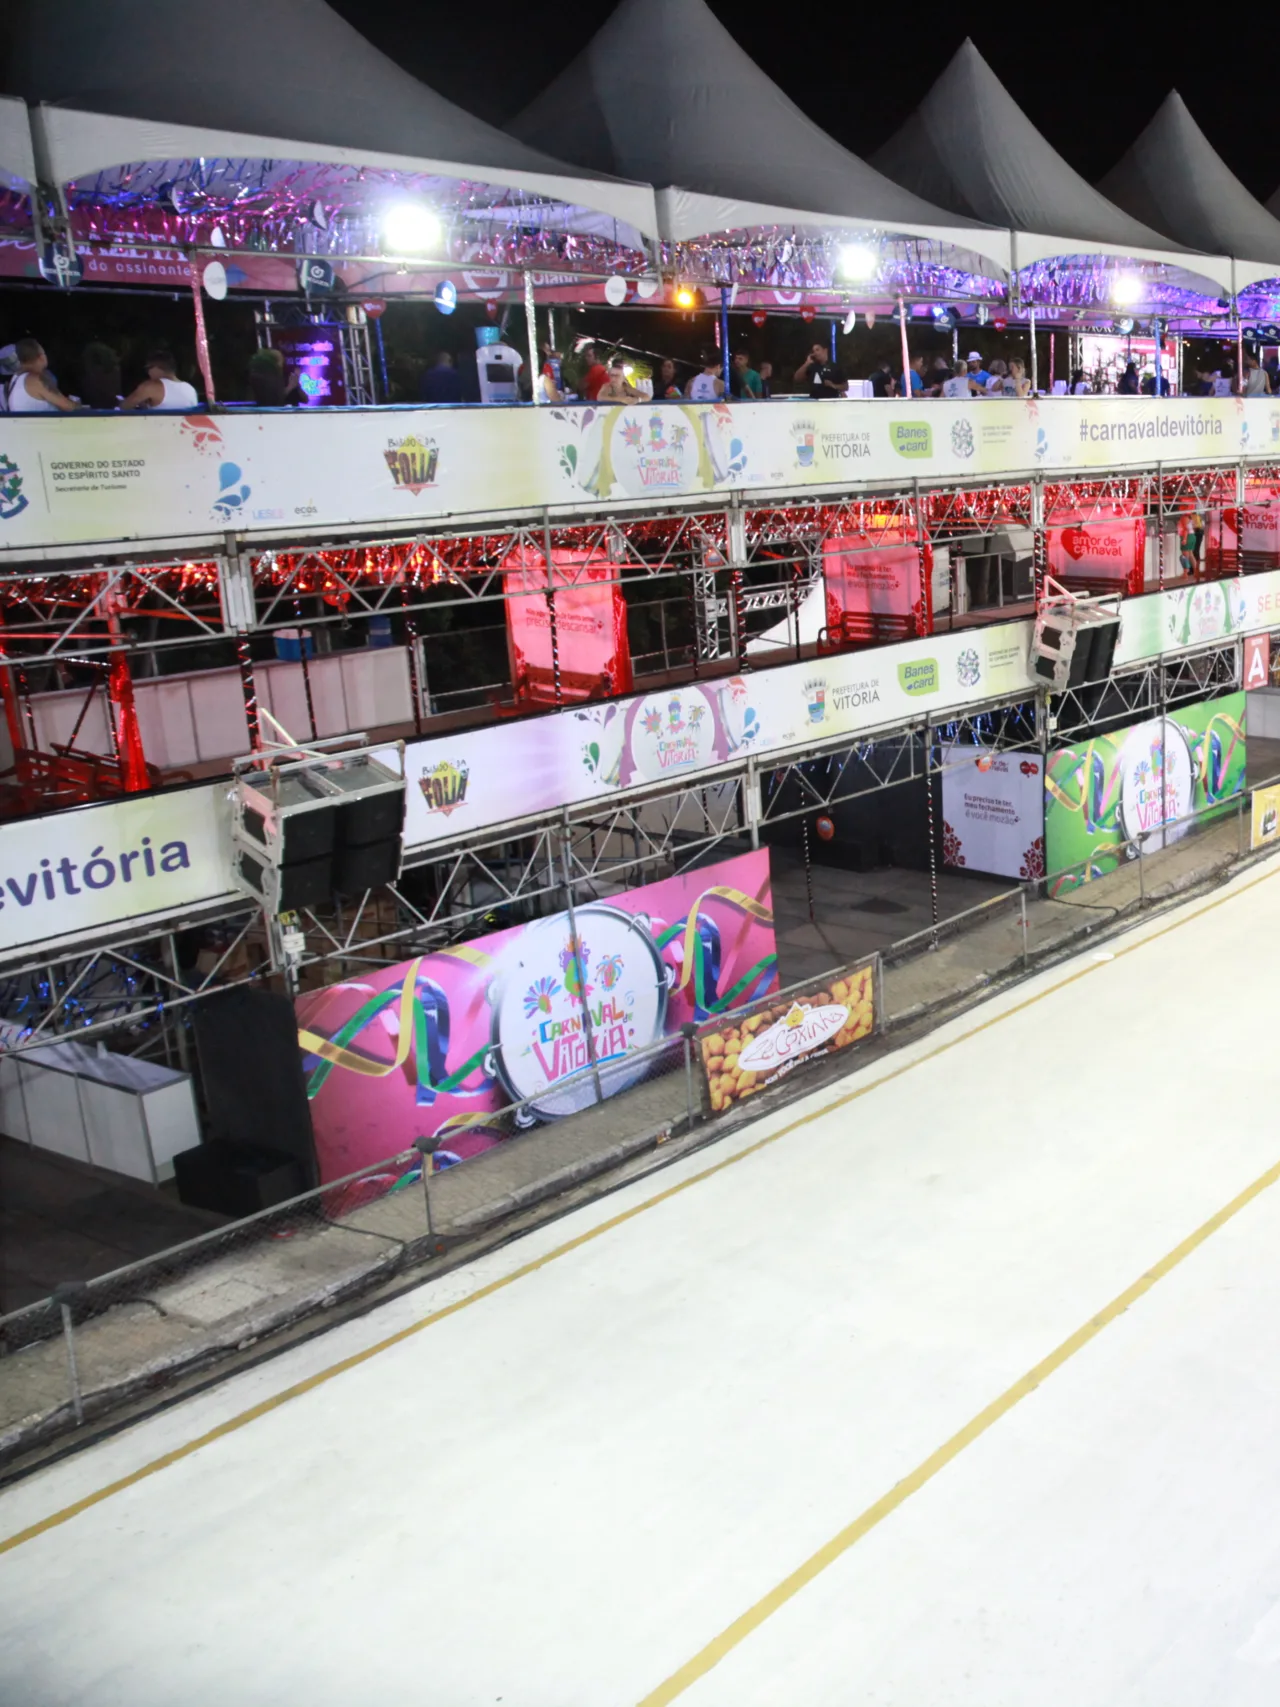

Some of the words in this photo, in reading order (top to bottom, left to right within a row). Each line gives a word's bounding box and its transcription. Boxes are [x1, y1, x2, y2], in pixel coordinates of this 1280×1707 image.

[88, 258, 108, 272] do
[116, 261, 191, 277] assinante
[896, 426, 928, 439] Banes
[1080, 413, 1222, 442] #carnavaldevitória
[821, 433, 860, 443] PREFEITURA
[861, 432, 871, 441] DE
[906, 439, 928, 452] card
[822, 441, 871, 459] VITÓRIA
[50, 460, 95, 470] GOVERNO
[96, 460, 110, 469] DO
[111, 459, 145, 468] ESTADO
[383, 448, 439, 485] FOLIA
[52, 472, 66, 481] DO
[68, 469, 110, 480] ESPÍRITO
[111, 469, 141, 479] SANTO
[1072, 536, 1102, 549] amor
[1103, 535, 1117, 547] de
[1073, 543, 1122, 557] carnaval
[1257, 596, 1271, 613] SE
[526, 616, 553, 629] precis
[904, 663, 934, 679] Banes
[1248, 647, 1265, 682] A
[832, 681, 869, 696] PREFEITURA
[870, 679, 880, 688] DE
[913, 676, 934, 690] card
[832, 689, 881, 711] VITÓRIA
[418, 768, 469, 809] FOLIA
[1139, 783, 1176, 804] CARNAAL
[978, 804, 1015, 816] fechamento
[0, 836, 190, 912] vitória
[539, 996, 625, 1045] CARNAVAL
[776, 1011, 845, 1056] Coxinha
